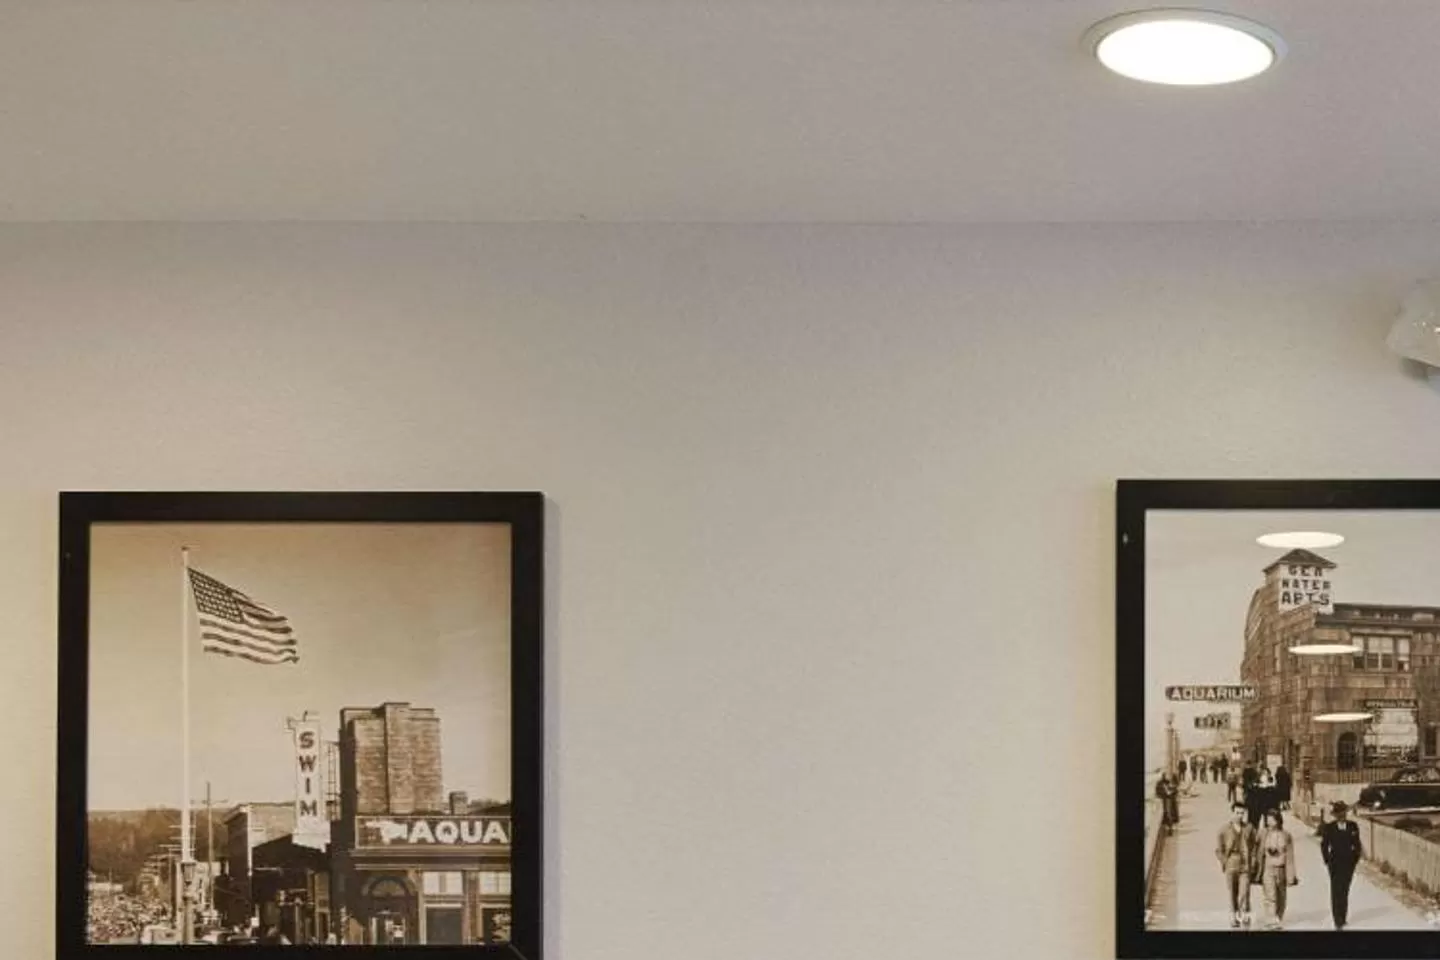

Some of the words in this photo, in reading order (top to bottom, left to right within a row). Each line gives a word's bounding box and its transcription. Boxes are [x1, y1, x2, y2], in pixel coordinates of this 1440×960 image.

[1171, 687, 1256, 699] AQUARIUM
[299, 731, 317, 817] SWIM
[408, 819, 509, 844] AQUA
